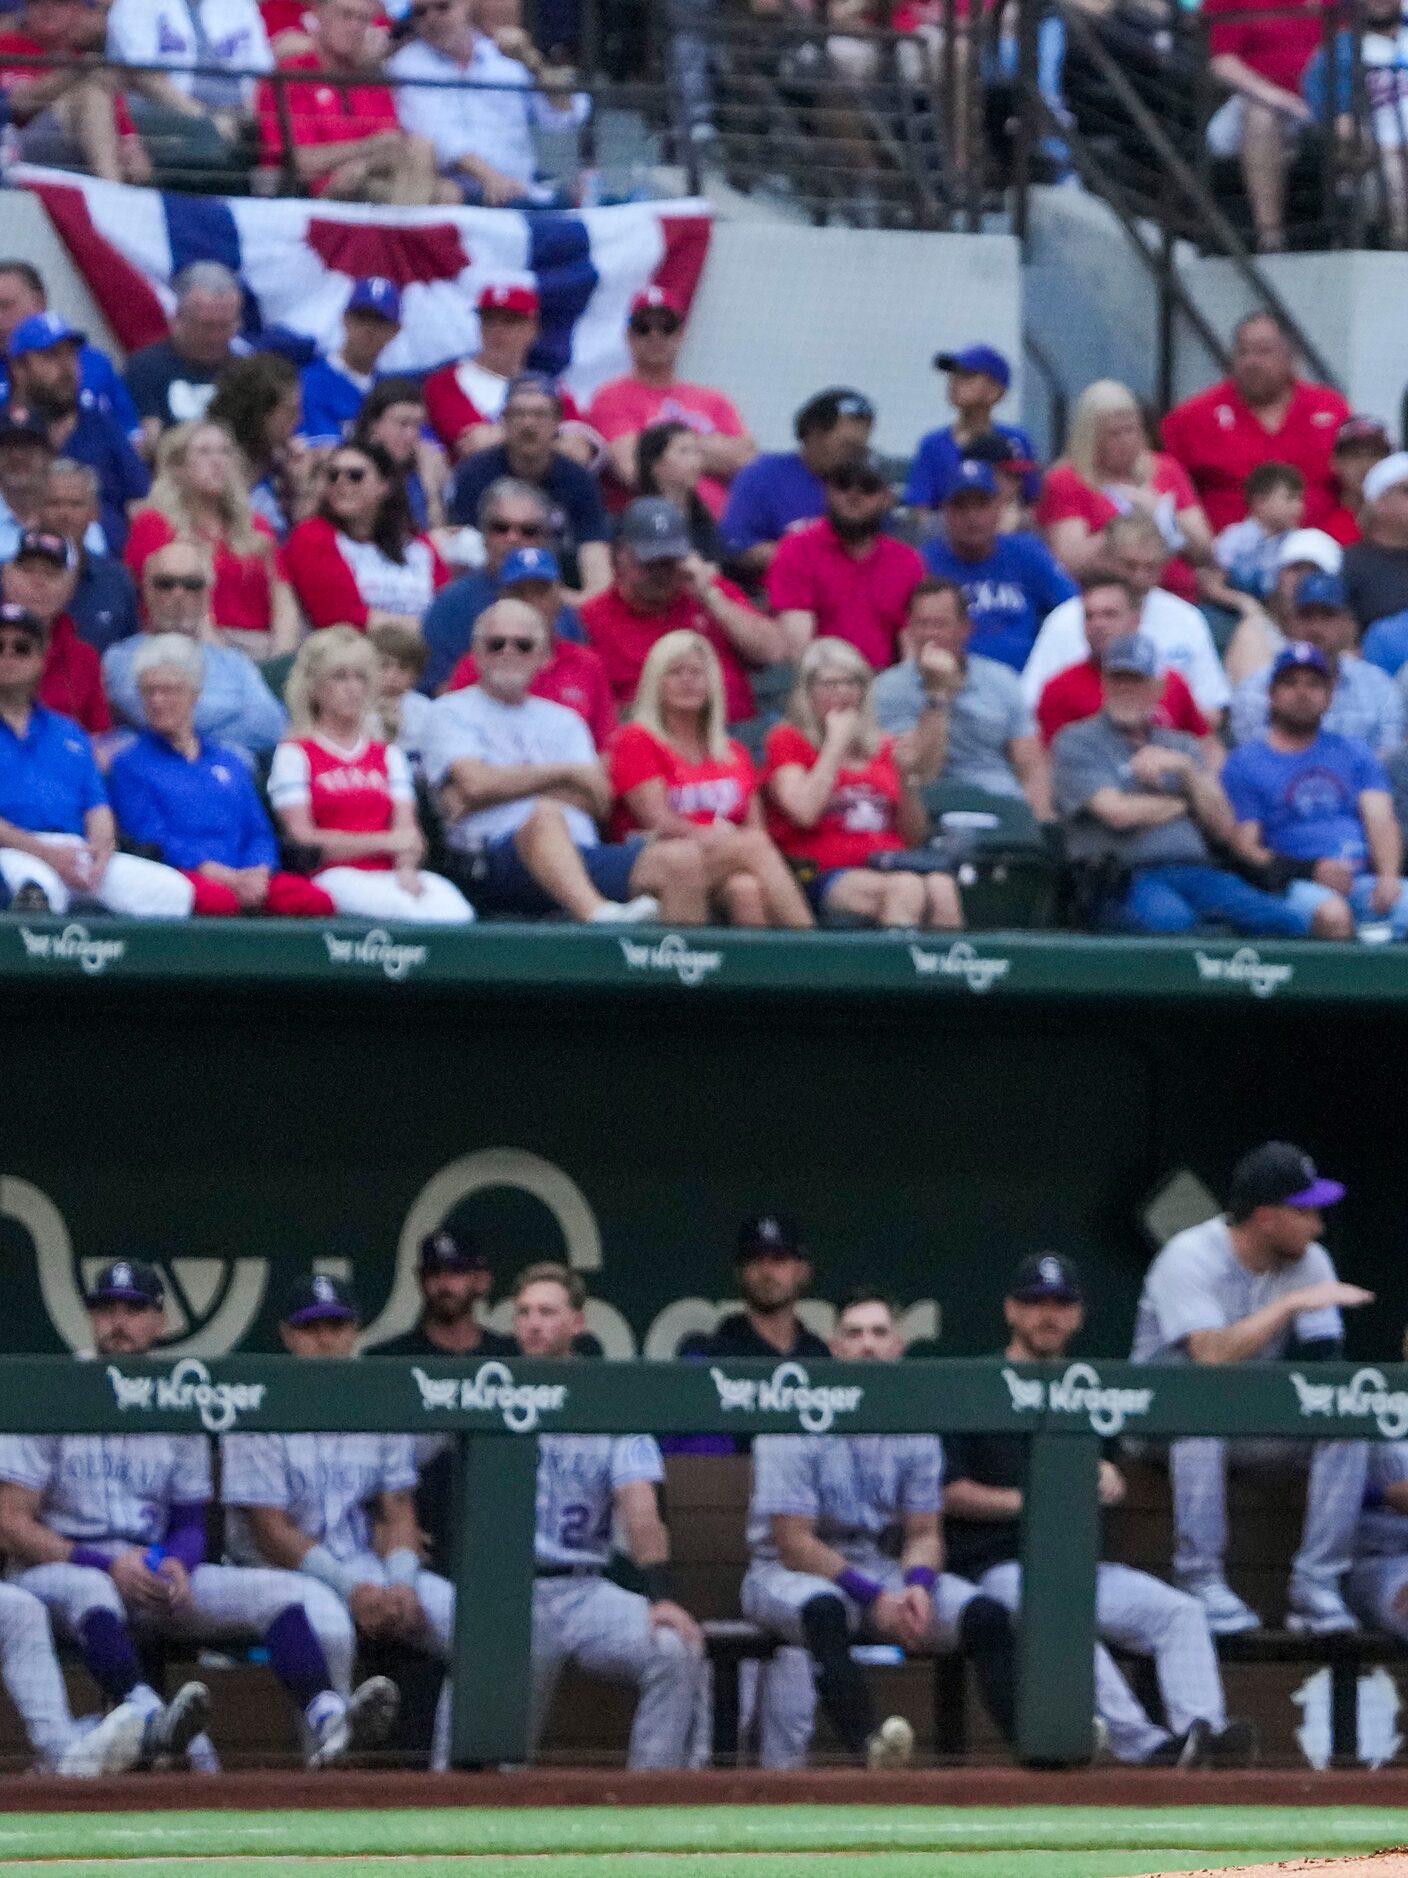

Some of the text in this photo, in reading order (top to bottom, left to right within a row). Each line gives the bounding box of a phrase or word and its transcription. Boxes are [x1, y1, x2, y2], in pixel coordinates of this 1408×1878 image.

[53, 923, 125, 974] Kroger
[355, 928, 428, 979] Kroger
[650, 933, 722, 985] Kroger
[157, 1357, 265, 1431] Kroger
[460, 1360, 568, 1432] Kroger
[757, 1362, 863, 1433] Kroger
[1048, 1362, 1154, 1435] Kroger
